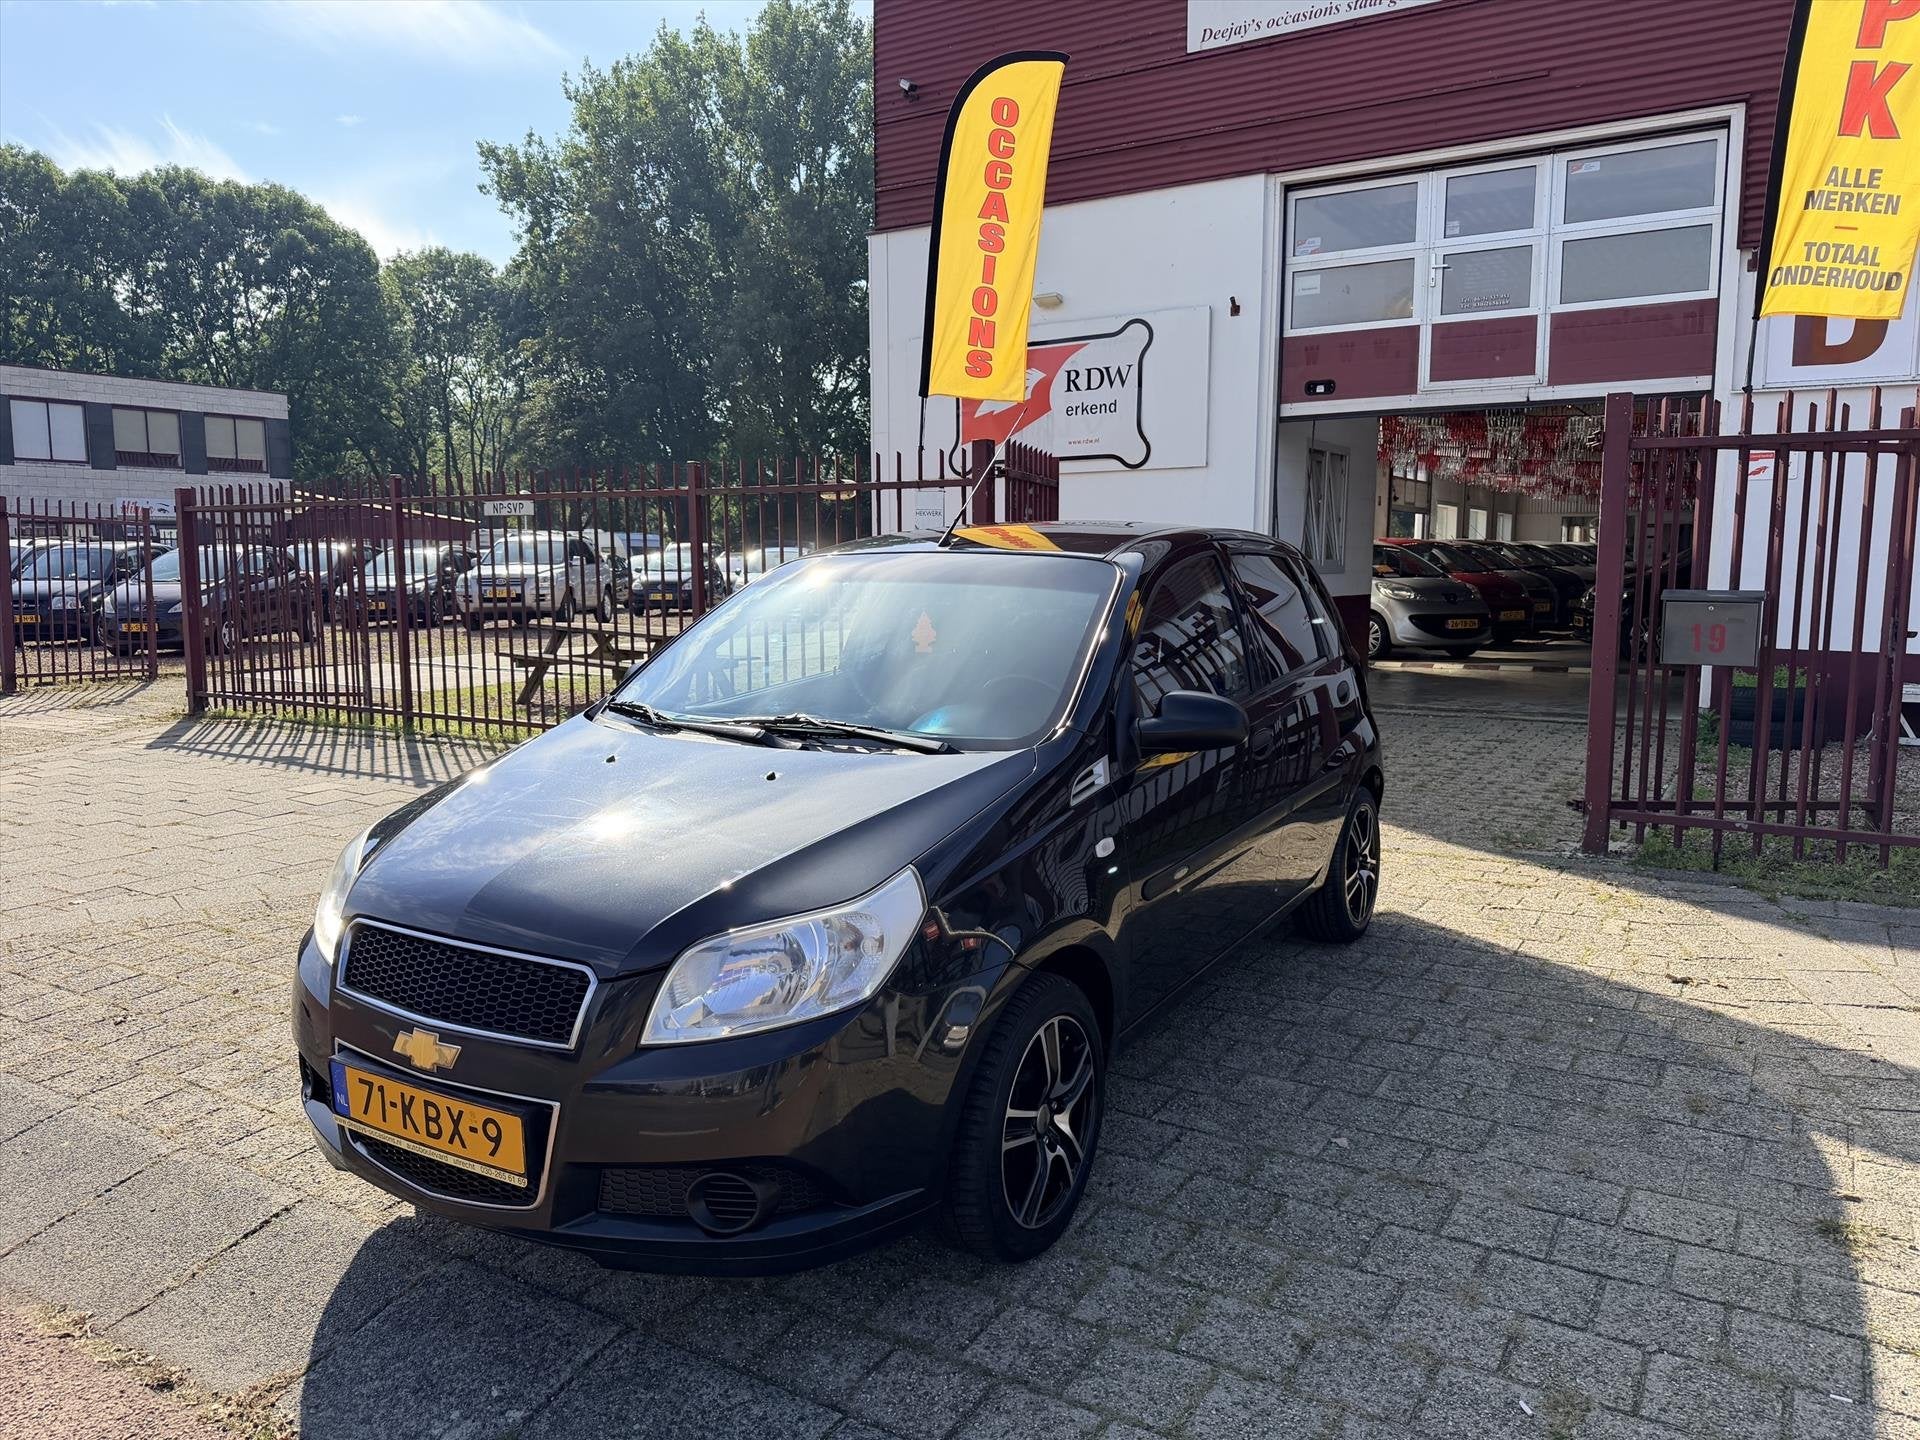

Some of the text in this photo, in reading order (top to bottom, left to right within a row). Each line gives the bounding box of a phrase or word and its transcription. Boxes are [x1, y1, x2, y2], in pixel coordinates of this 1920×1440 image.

[1200, 19, 1262, 43] Deejay's
[1267, 2, 1341, 28] occasions
[1825, 166, 1883, 190] ALLE
[1803, 190, 1901, 215] MERKEN
[965, 97, 1019, 378] OCCASIONS
[1803, 241, 1880, 267] TOTAAL
[1770, 265, 1903, 291] ONDERHOUD
[1065, 364, 1133, 392] RDW
[1066, 400, 1117, 416] erkend
[1691, 623, 1726, 654] 19
[336, 1093, 348, 1107] NL
[358, 1077, 502, 1157] 71-KBX-9
[480, 1166, 507, 1181] 030-265
[508, 1174, 516, 1183] 61
[517, 1176, 526, 1187] 69
